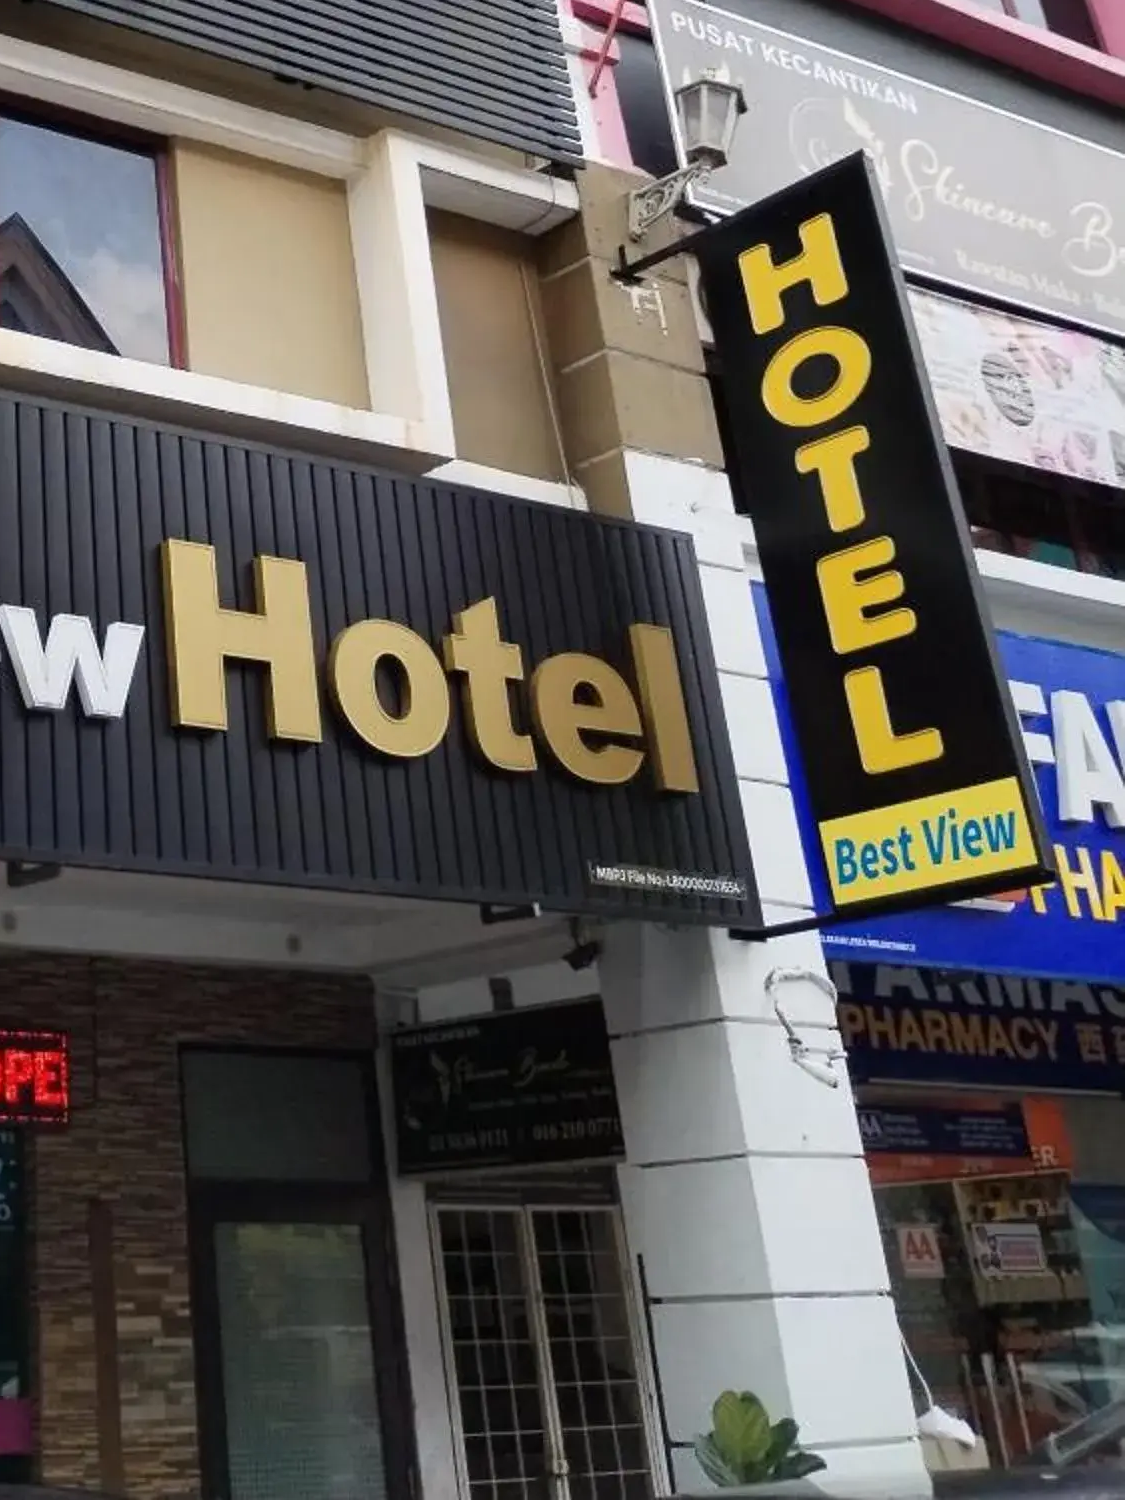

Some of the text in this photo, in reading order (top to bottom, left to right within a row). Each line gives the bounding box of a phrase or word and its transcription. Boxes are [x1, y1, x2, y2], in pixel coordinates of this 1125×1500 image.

[670, 11, 918, 114] PUSAT KECANTIKAN
[737, 212, 944, 775] HOTEL
[160, 537, 700, 794] Hotel
[1008, 679, 1125, 828] FA
[834, 808, 1016, 885] Best View
[839, 1003, 1059, 1063] PHARMACY
